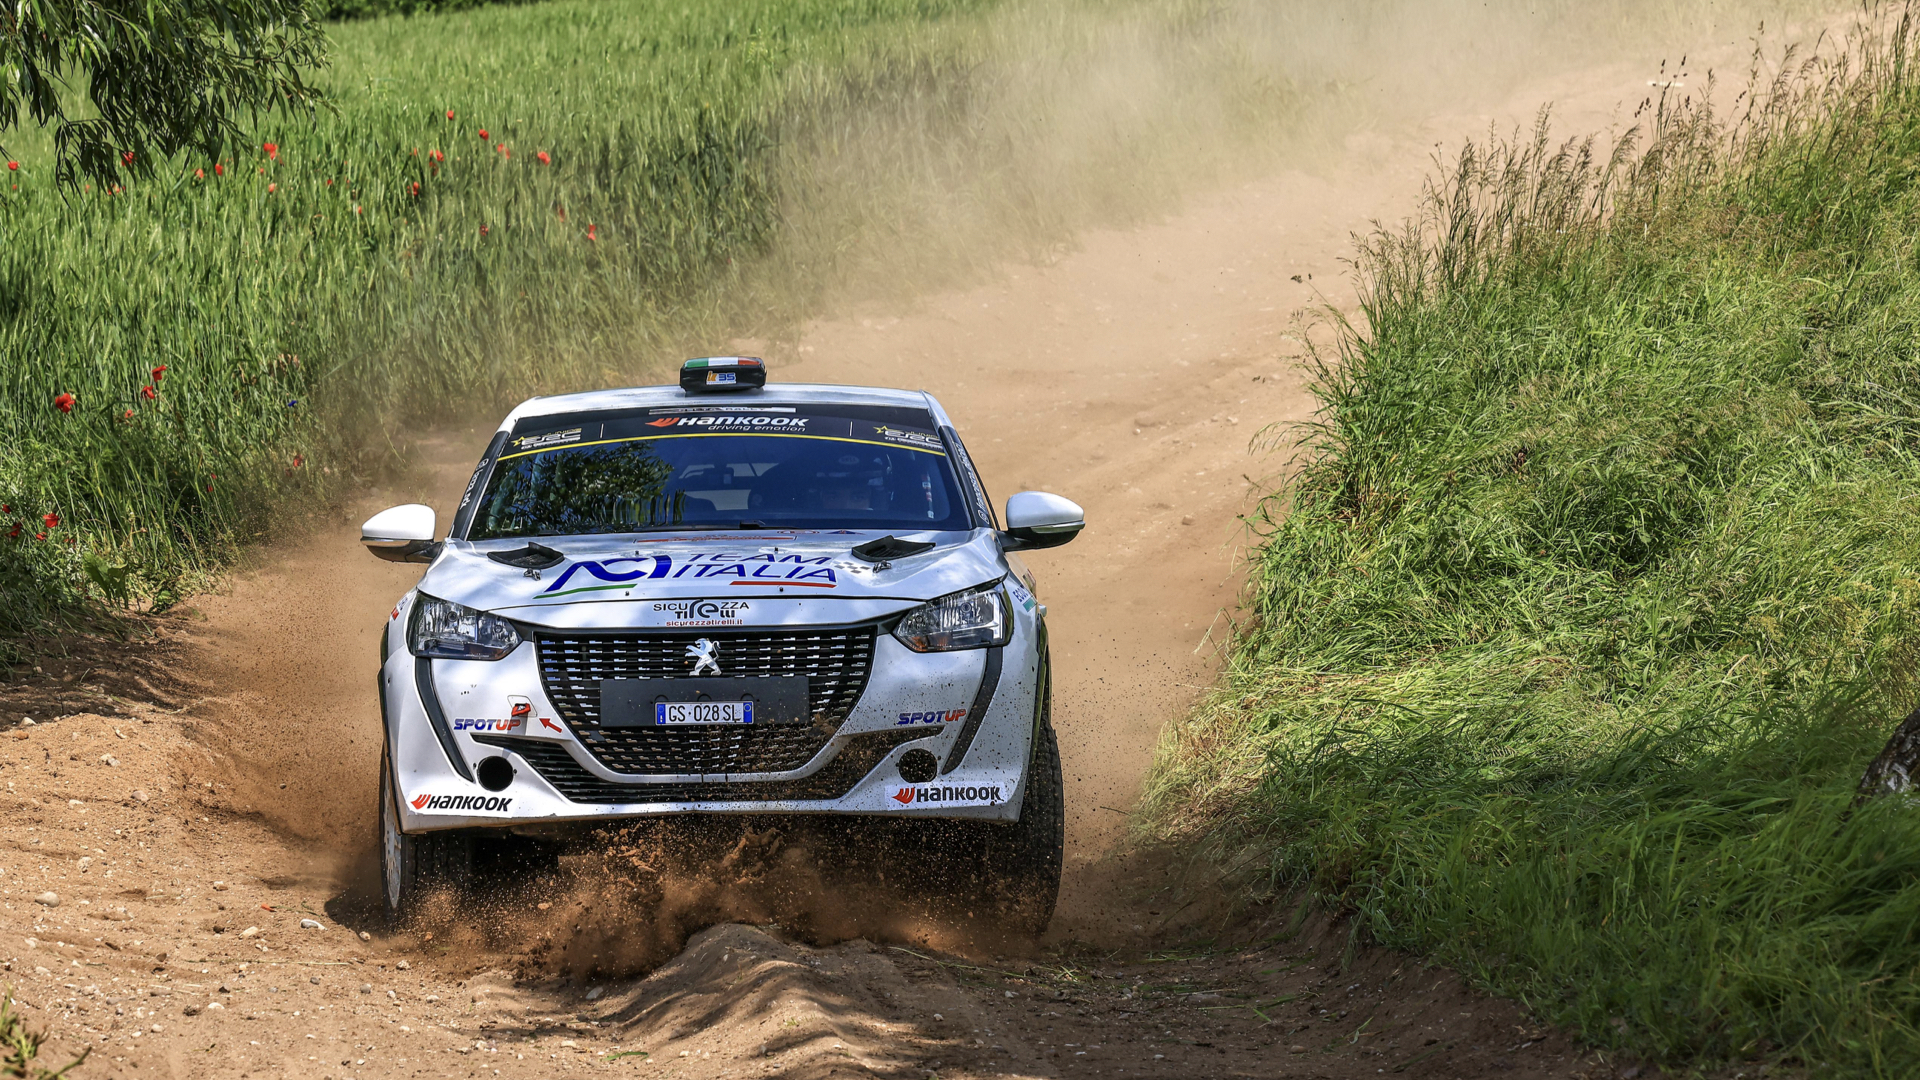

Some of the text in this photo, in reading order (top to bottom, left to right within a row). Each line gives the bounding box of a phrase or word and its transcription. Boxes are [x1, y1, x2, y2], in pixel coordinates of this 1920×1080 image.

[677, 416, 809, 427] HANKOOK
[688, 553, 833, 565] TEAM
[544, 555, 672, 592] ACI
[672, 564, 837, 583] ITALIA
[666, 619, 743, 627] sicurezzatirelli.it
[668, 705, 686, 722] GS
[693, 705, 720, 722] 028
[723, 705, 742, 722] SL
[896, 709, 967, 725] SPOTUP
[454, 719, 521, 730] SPOTUP
[916, 786, 1001, 803] HANKOOK
[427, 795, 513, 812] HANKOOK
